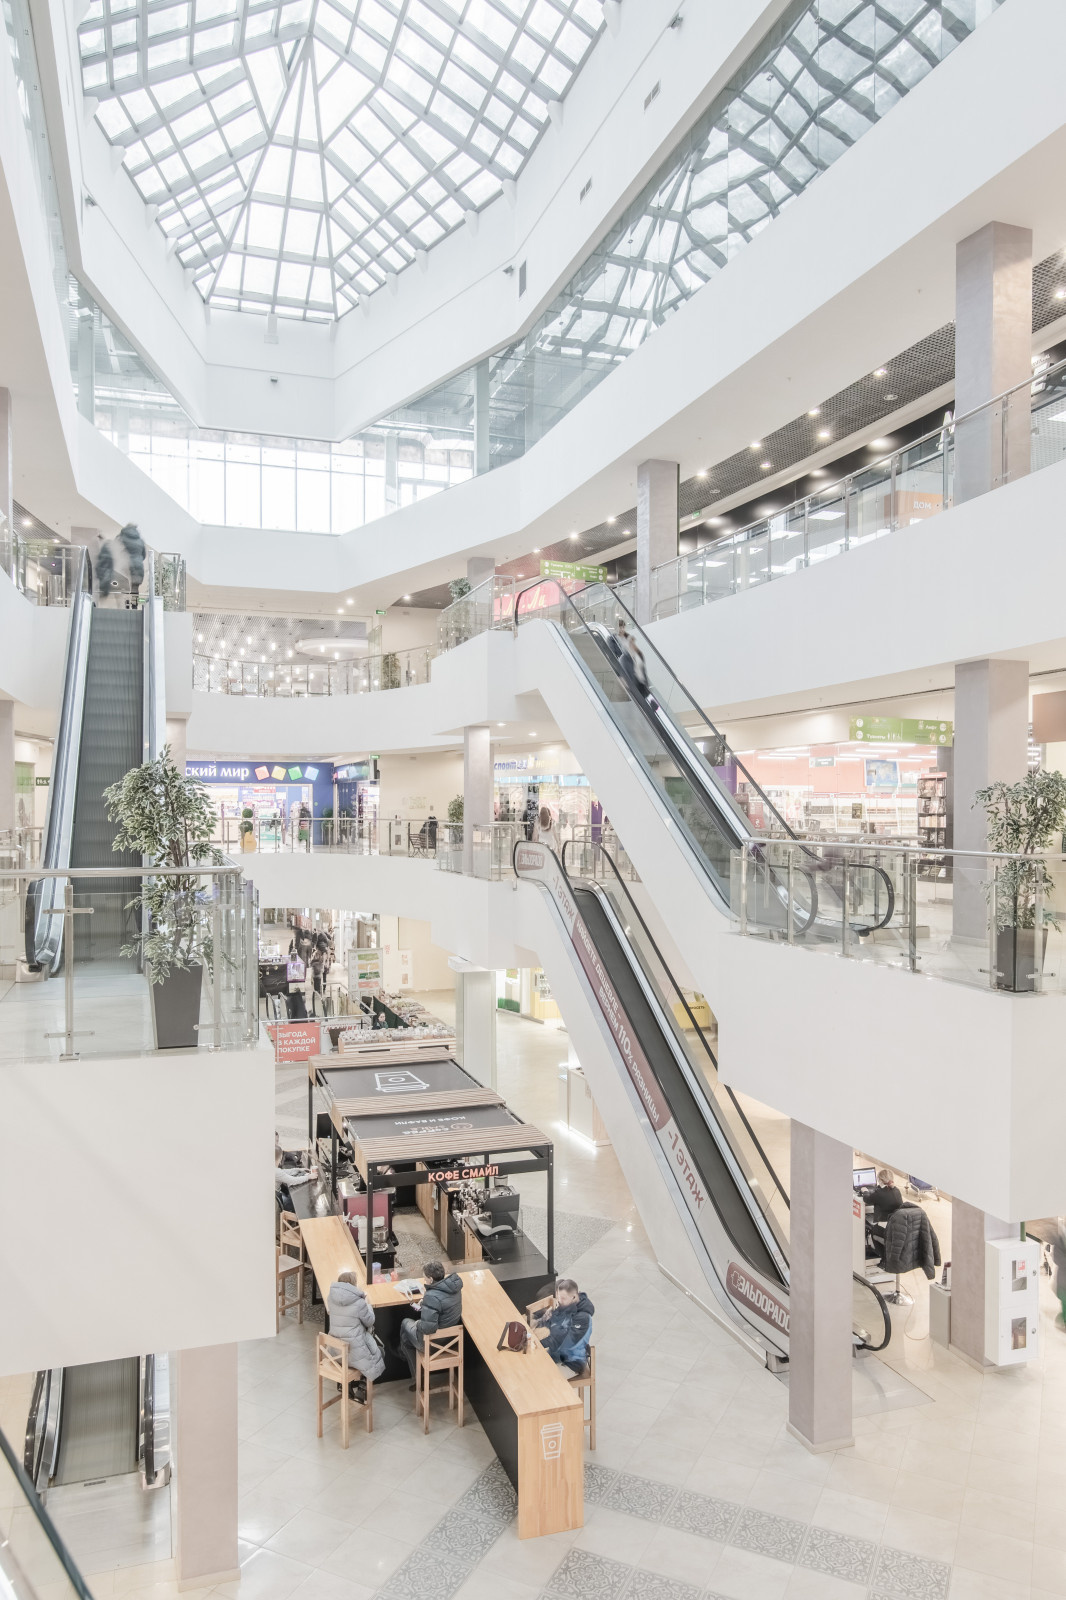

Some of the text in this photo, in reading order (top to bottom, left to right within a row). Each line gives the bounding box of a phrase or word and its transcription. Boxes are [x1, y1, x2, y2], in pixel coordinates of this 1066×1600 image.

[220, 766, 249, 780] мир
[283, 1036, 316, 1046] КАЖДОЙ
[618, 1025, 634, 1063] 110%
[632, 1061, 660, 1122] РАЗНИЦЫ
[428, 1164, 499, 1183] КОФЕ СМАЙЛ
[675, 1148, 705, 1209] ЭТАЖ
